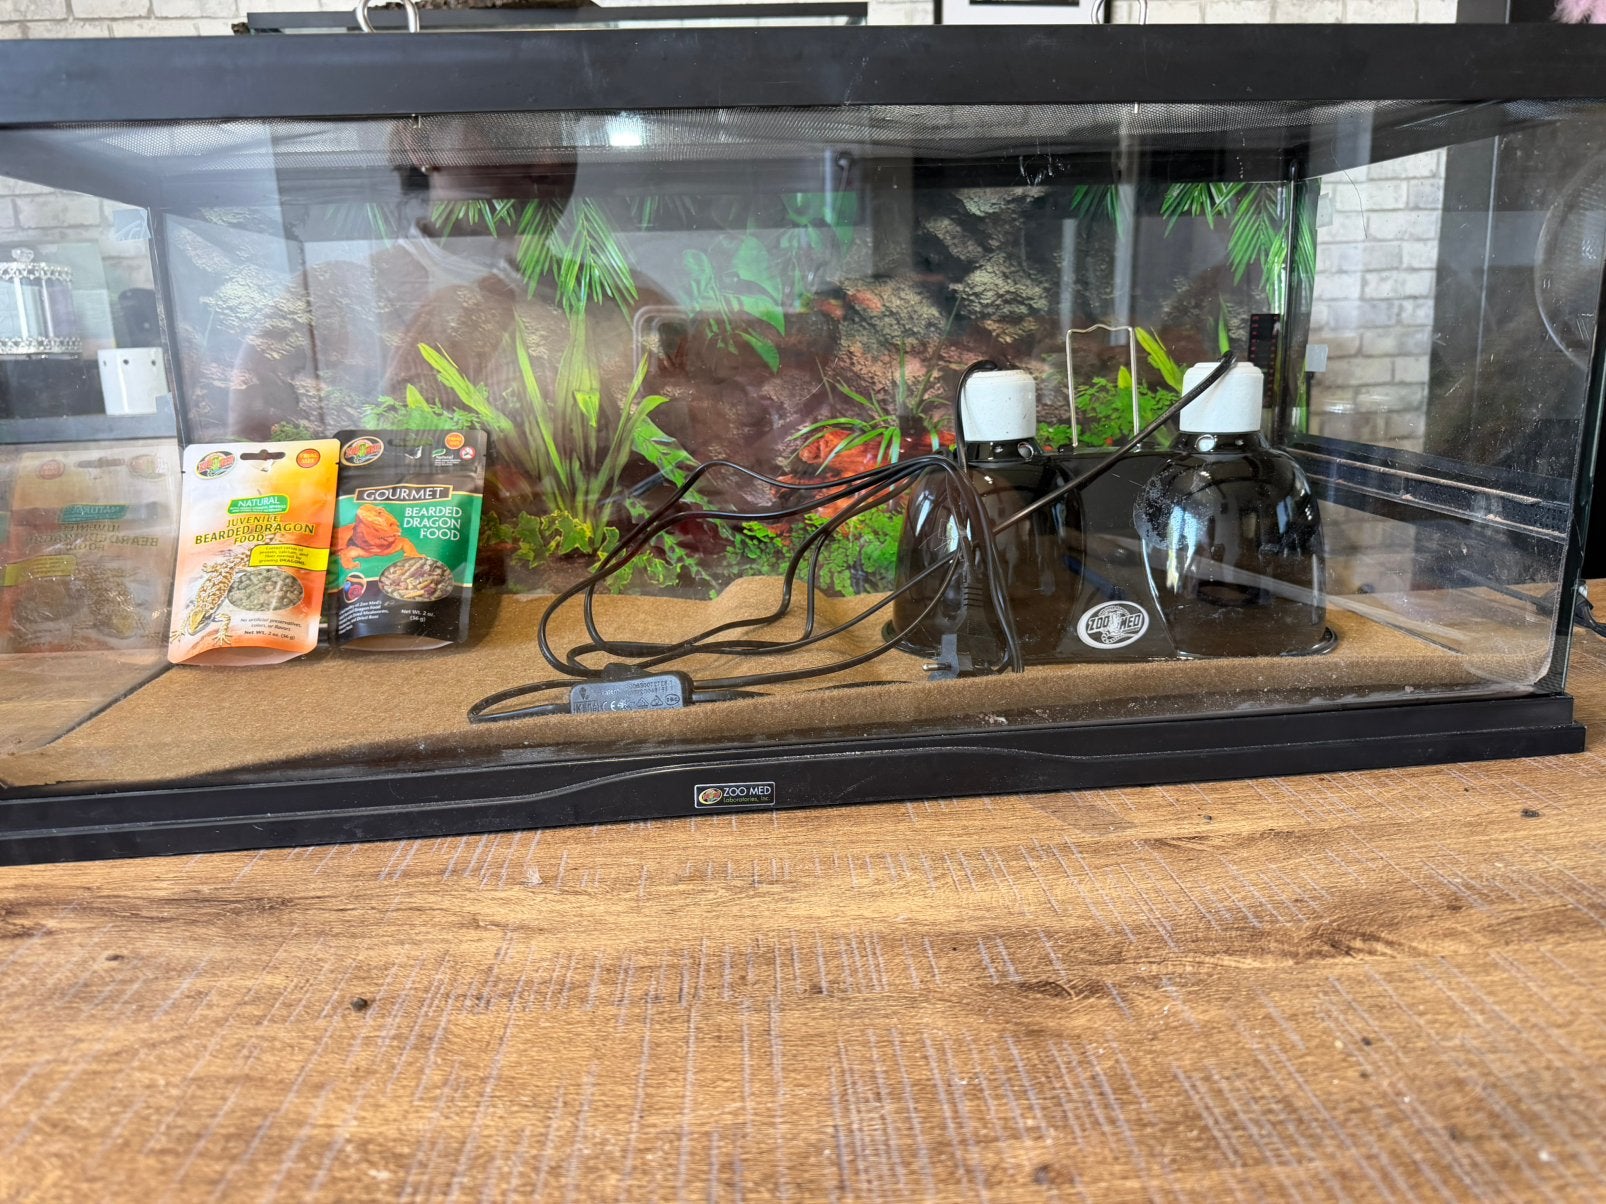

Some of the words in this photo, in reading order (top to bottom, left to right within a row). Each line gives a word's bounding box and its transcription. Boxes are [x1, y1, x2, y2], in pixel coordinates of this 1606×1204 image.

[363, 487, 444, 501] GOURMET
[237, 496, 280, 508] NATURAL
[405, 506, 462, 517] BEARDED
[226, 515, 280, 528] JUVENILE
[403, 517, 461, 529] DRAGON
[195, 524, 254, 545] BEARDED
[254, 523, 315, 535] DRAGON
[233, 534, 265, 545] FOOD
[420, 528, 460, 541] FOOD
[1088, 615, 1110, 632] ZOO
[1120, 613, 1141, 629] MED
[723, 786, 747, 797] ZOO
[749, 785, 772, 796] MED
